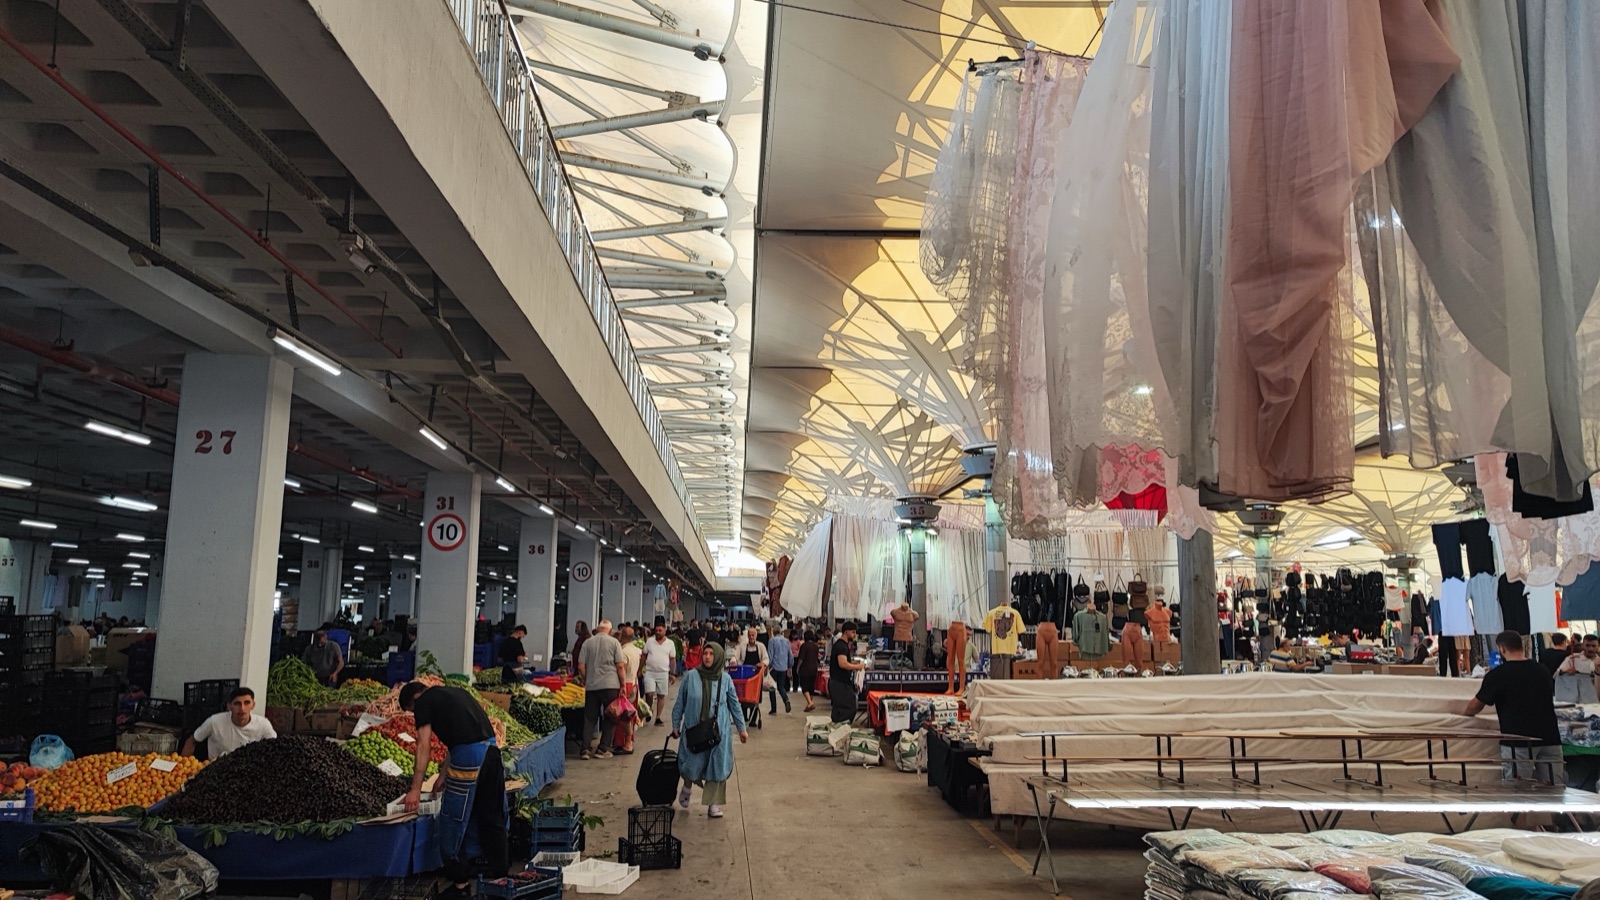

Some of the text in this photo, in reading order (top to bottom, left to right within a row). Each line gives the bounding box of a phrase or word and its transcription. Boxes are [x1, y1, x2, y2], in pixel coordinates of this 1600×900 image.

[194, 429, 237, 454] 27
[436, 496, 455, 510] 31
[909, 506, 926, 516] 35
[1260, 511, 1275, 520] 35
[436, 523, 458, 540] 10
[528, 544, 545, 555] 36
[1, 558, 15, 566] 37
[576, 566, 588, 577] 10
